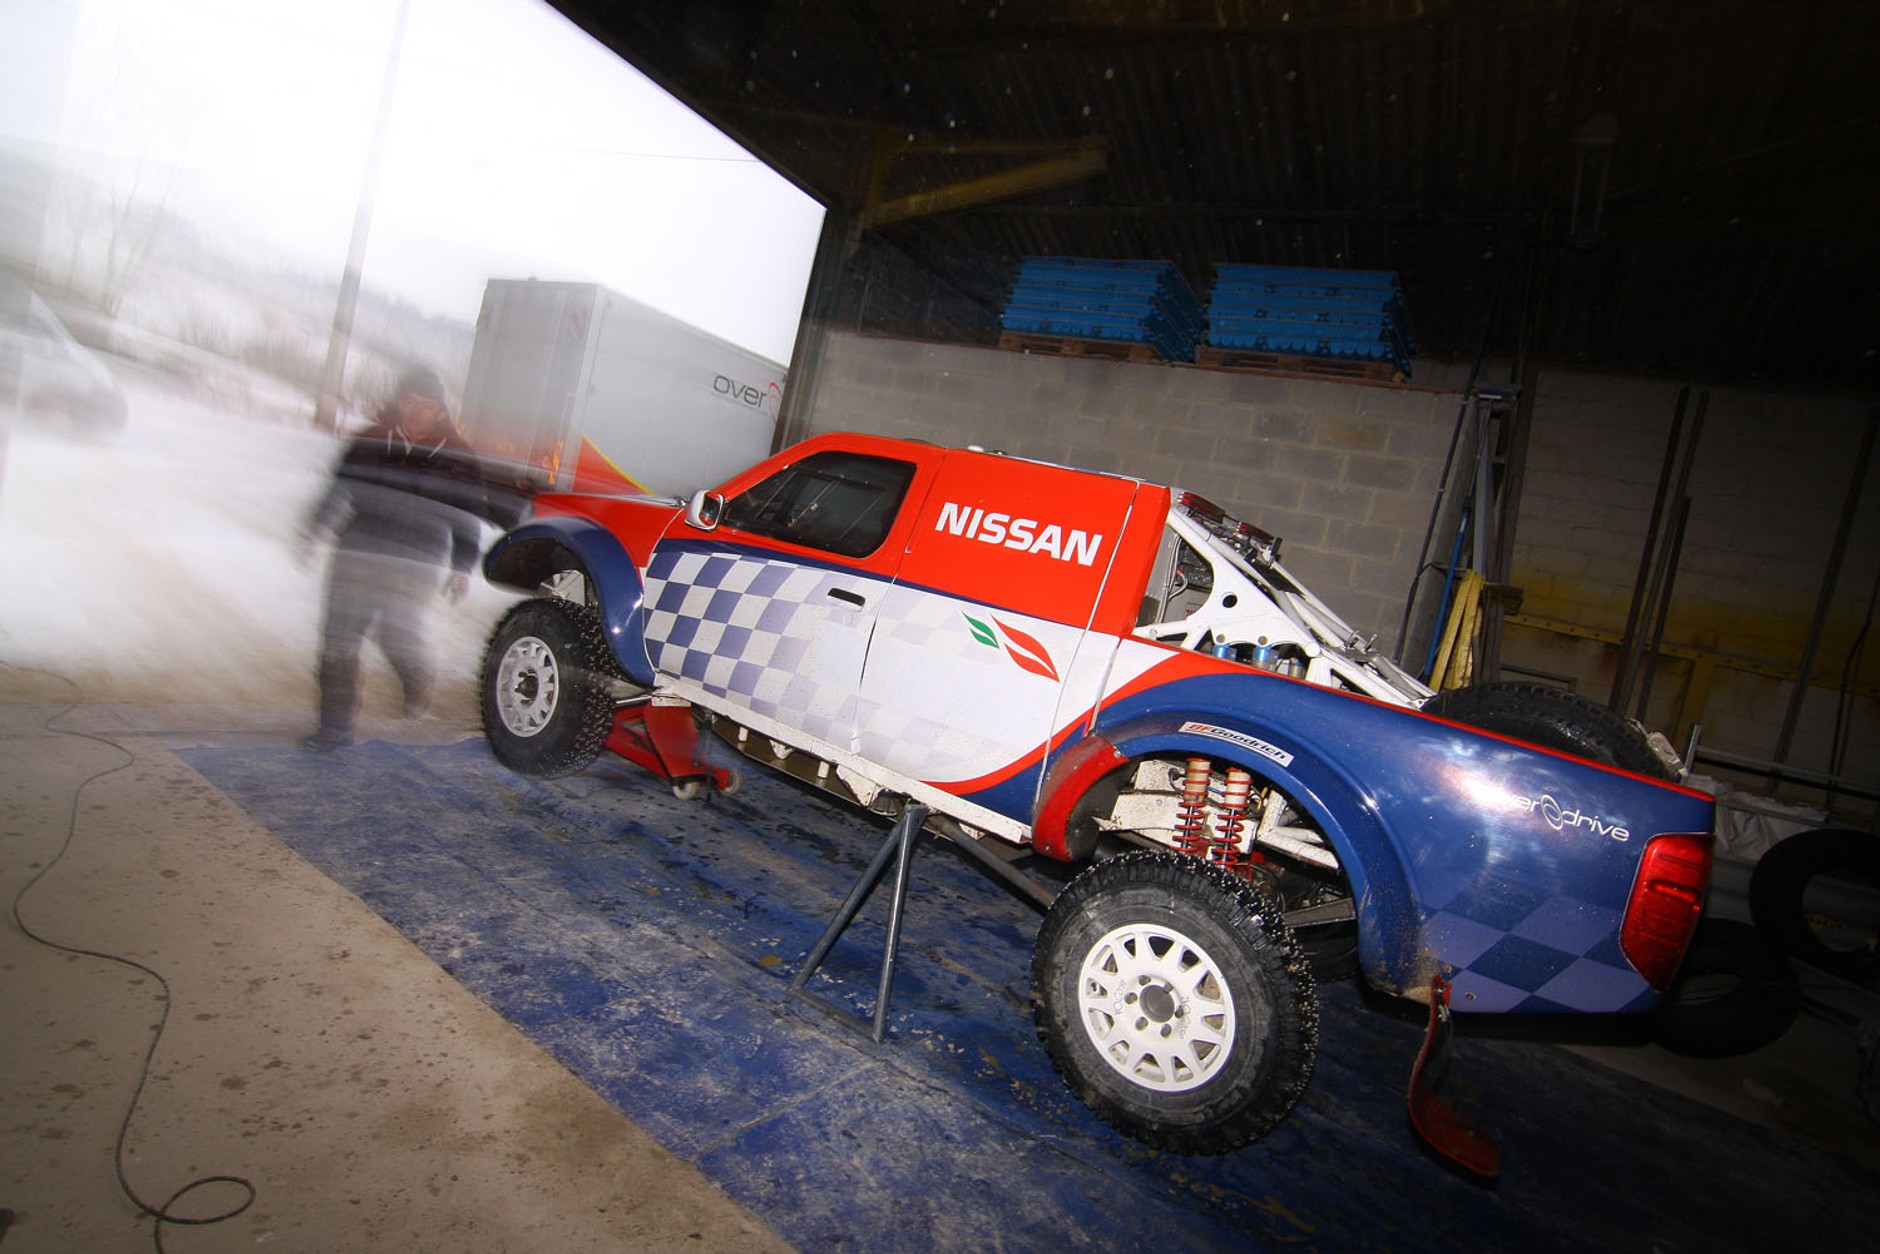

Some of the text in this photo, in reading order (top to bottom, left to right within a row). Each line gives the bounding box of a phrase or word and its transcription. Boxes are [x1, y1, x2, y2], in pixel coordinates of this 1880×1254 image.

[713, 375, 767, 408] over
[935, 501, 1103, 567] NISSAN
[1188, 723, 1286, 760] BFGoodrich
[1561, 809, 1630, 842] drive
